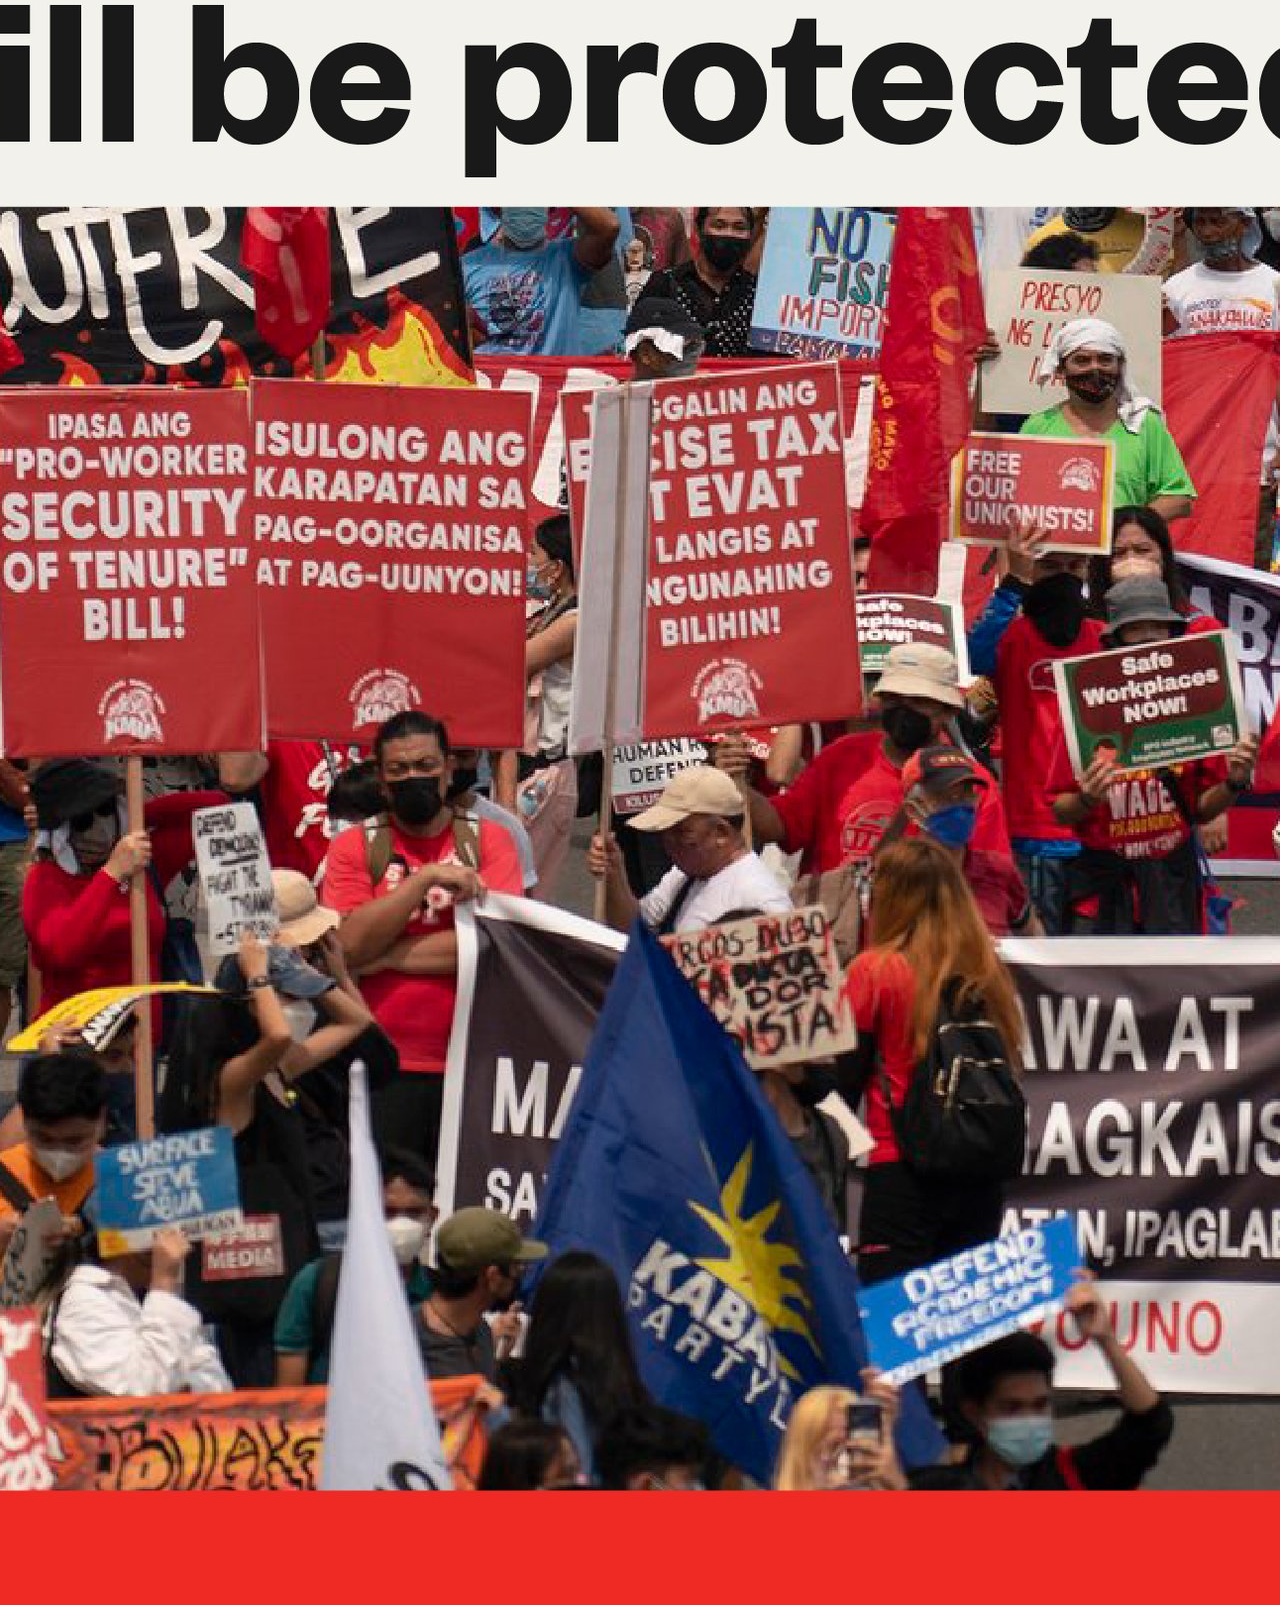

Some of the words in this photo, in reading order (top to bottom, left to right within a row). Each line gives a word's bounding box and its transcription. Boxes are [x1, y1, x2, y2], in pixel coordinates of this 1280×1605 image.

[1021, 281, 1103, 313] PRESYO
[756, 381, 817, 412] ANG
[48, 412, 125, 440] IPASA
[131, 412, 192, 439] ANG
[255, 421, 429, 466] ISULONG
[439, 430, 526, 467] ANG
[747, 411, 841, 461] TAX
[966, 449, 1021, 476] FREE
[254, 468, 468, 510] KARAPATAN
[477, 475, 526, 510] SA
[686, 465, 804, 519] EVAT
[966, 474, 1017, 500] OUR
[2, 488, 248, 540] SECURITY
[966, 503, 1095, 533] UNIONISTS!
[254, 517, 524, 555] PAG-OORGANISA
[656, 524, 772, 564] LANGIS
[781, 518, 819, 550] AT
[3, 550, 59, 591] OF
[256, 561, 299, 588] AT
[308, 562, 522, 597] PAG-UUNYON!
[83, 598, 186, 642] BILL!
[660, 607, 781, 647] BILIHIN!
[1122, 652, 1174, 675] Safe
[1083, 668, 1219, 707] Workplaces
[1124, 697, 1188, 723] NOW!
[1166, 996, 1254, 1072] AT
[208, 1249, 276, 1271] MEDIA
[903, 1228, 1045, 1304] DEFEND
[1119, 1299, 1221, 1356] UNO
